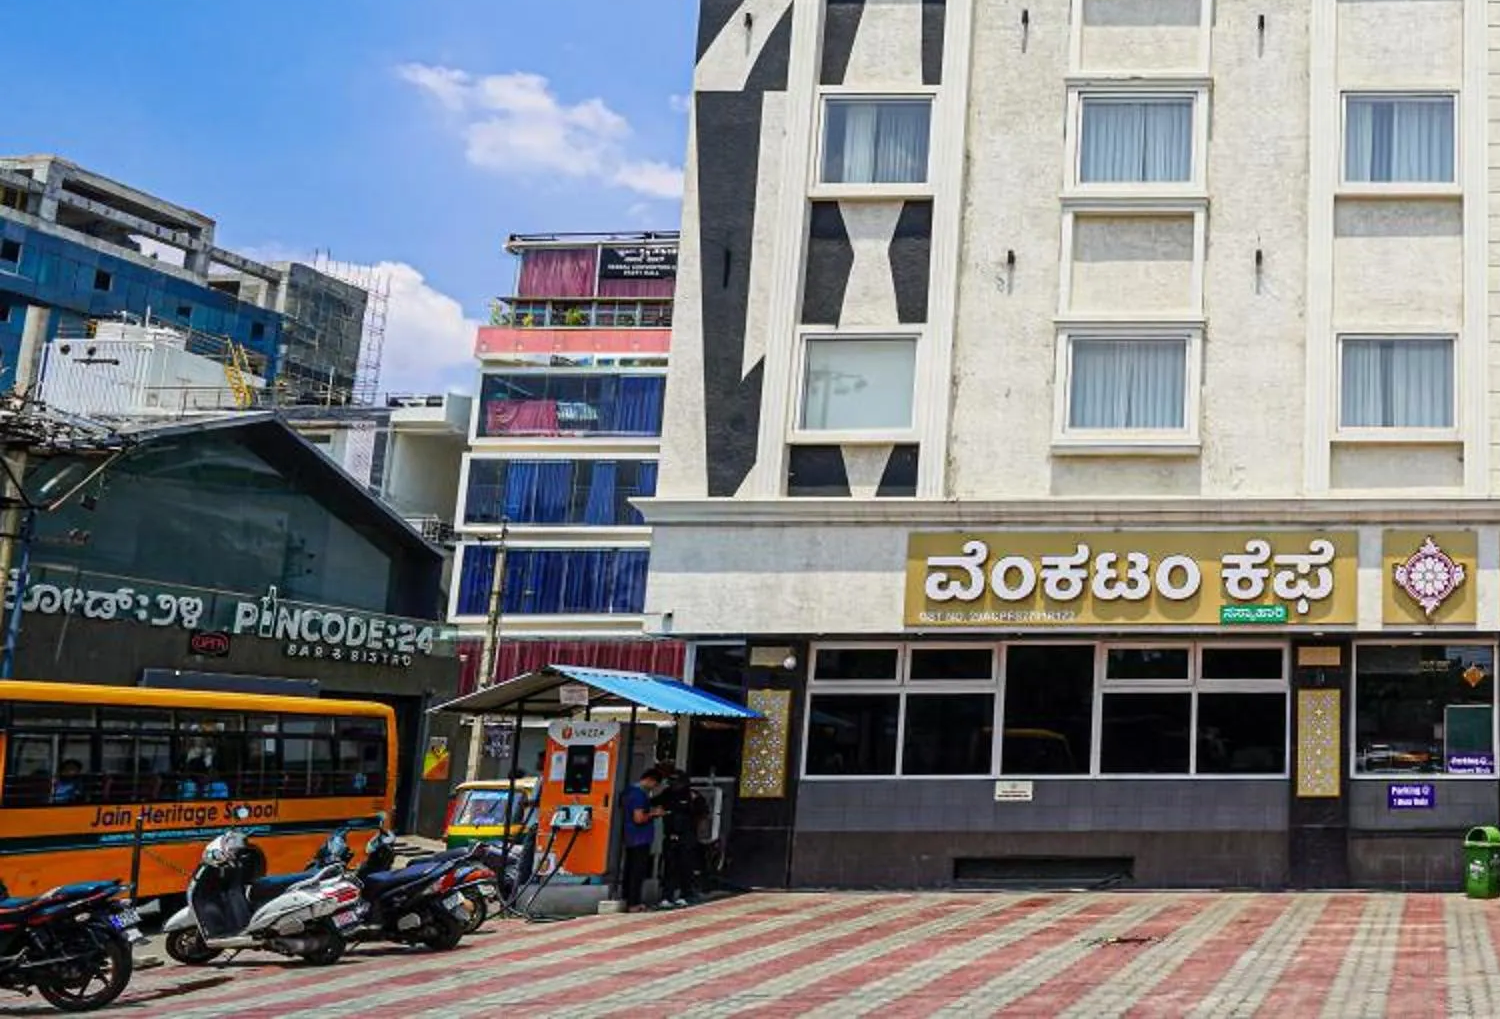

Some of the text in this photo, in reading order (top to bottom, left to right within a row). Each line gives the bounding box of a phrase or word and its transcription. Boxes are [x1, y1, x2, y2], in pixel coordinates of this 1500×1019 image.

[924, 539, 1335, 614] ವೆಂಕಟಂ ಕೆಫೆ
[287, 644, 323, 658] BAR
[351, 650, 411, 666] BISTRO
[91, 799, 279, 827] Jain Heritage Sool
